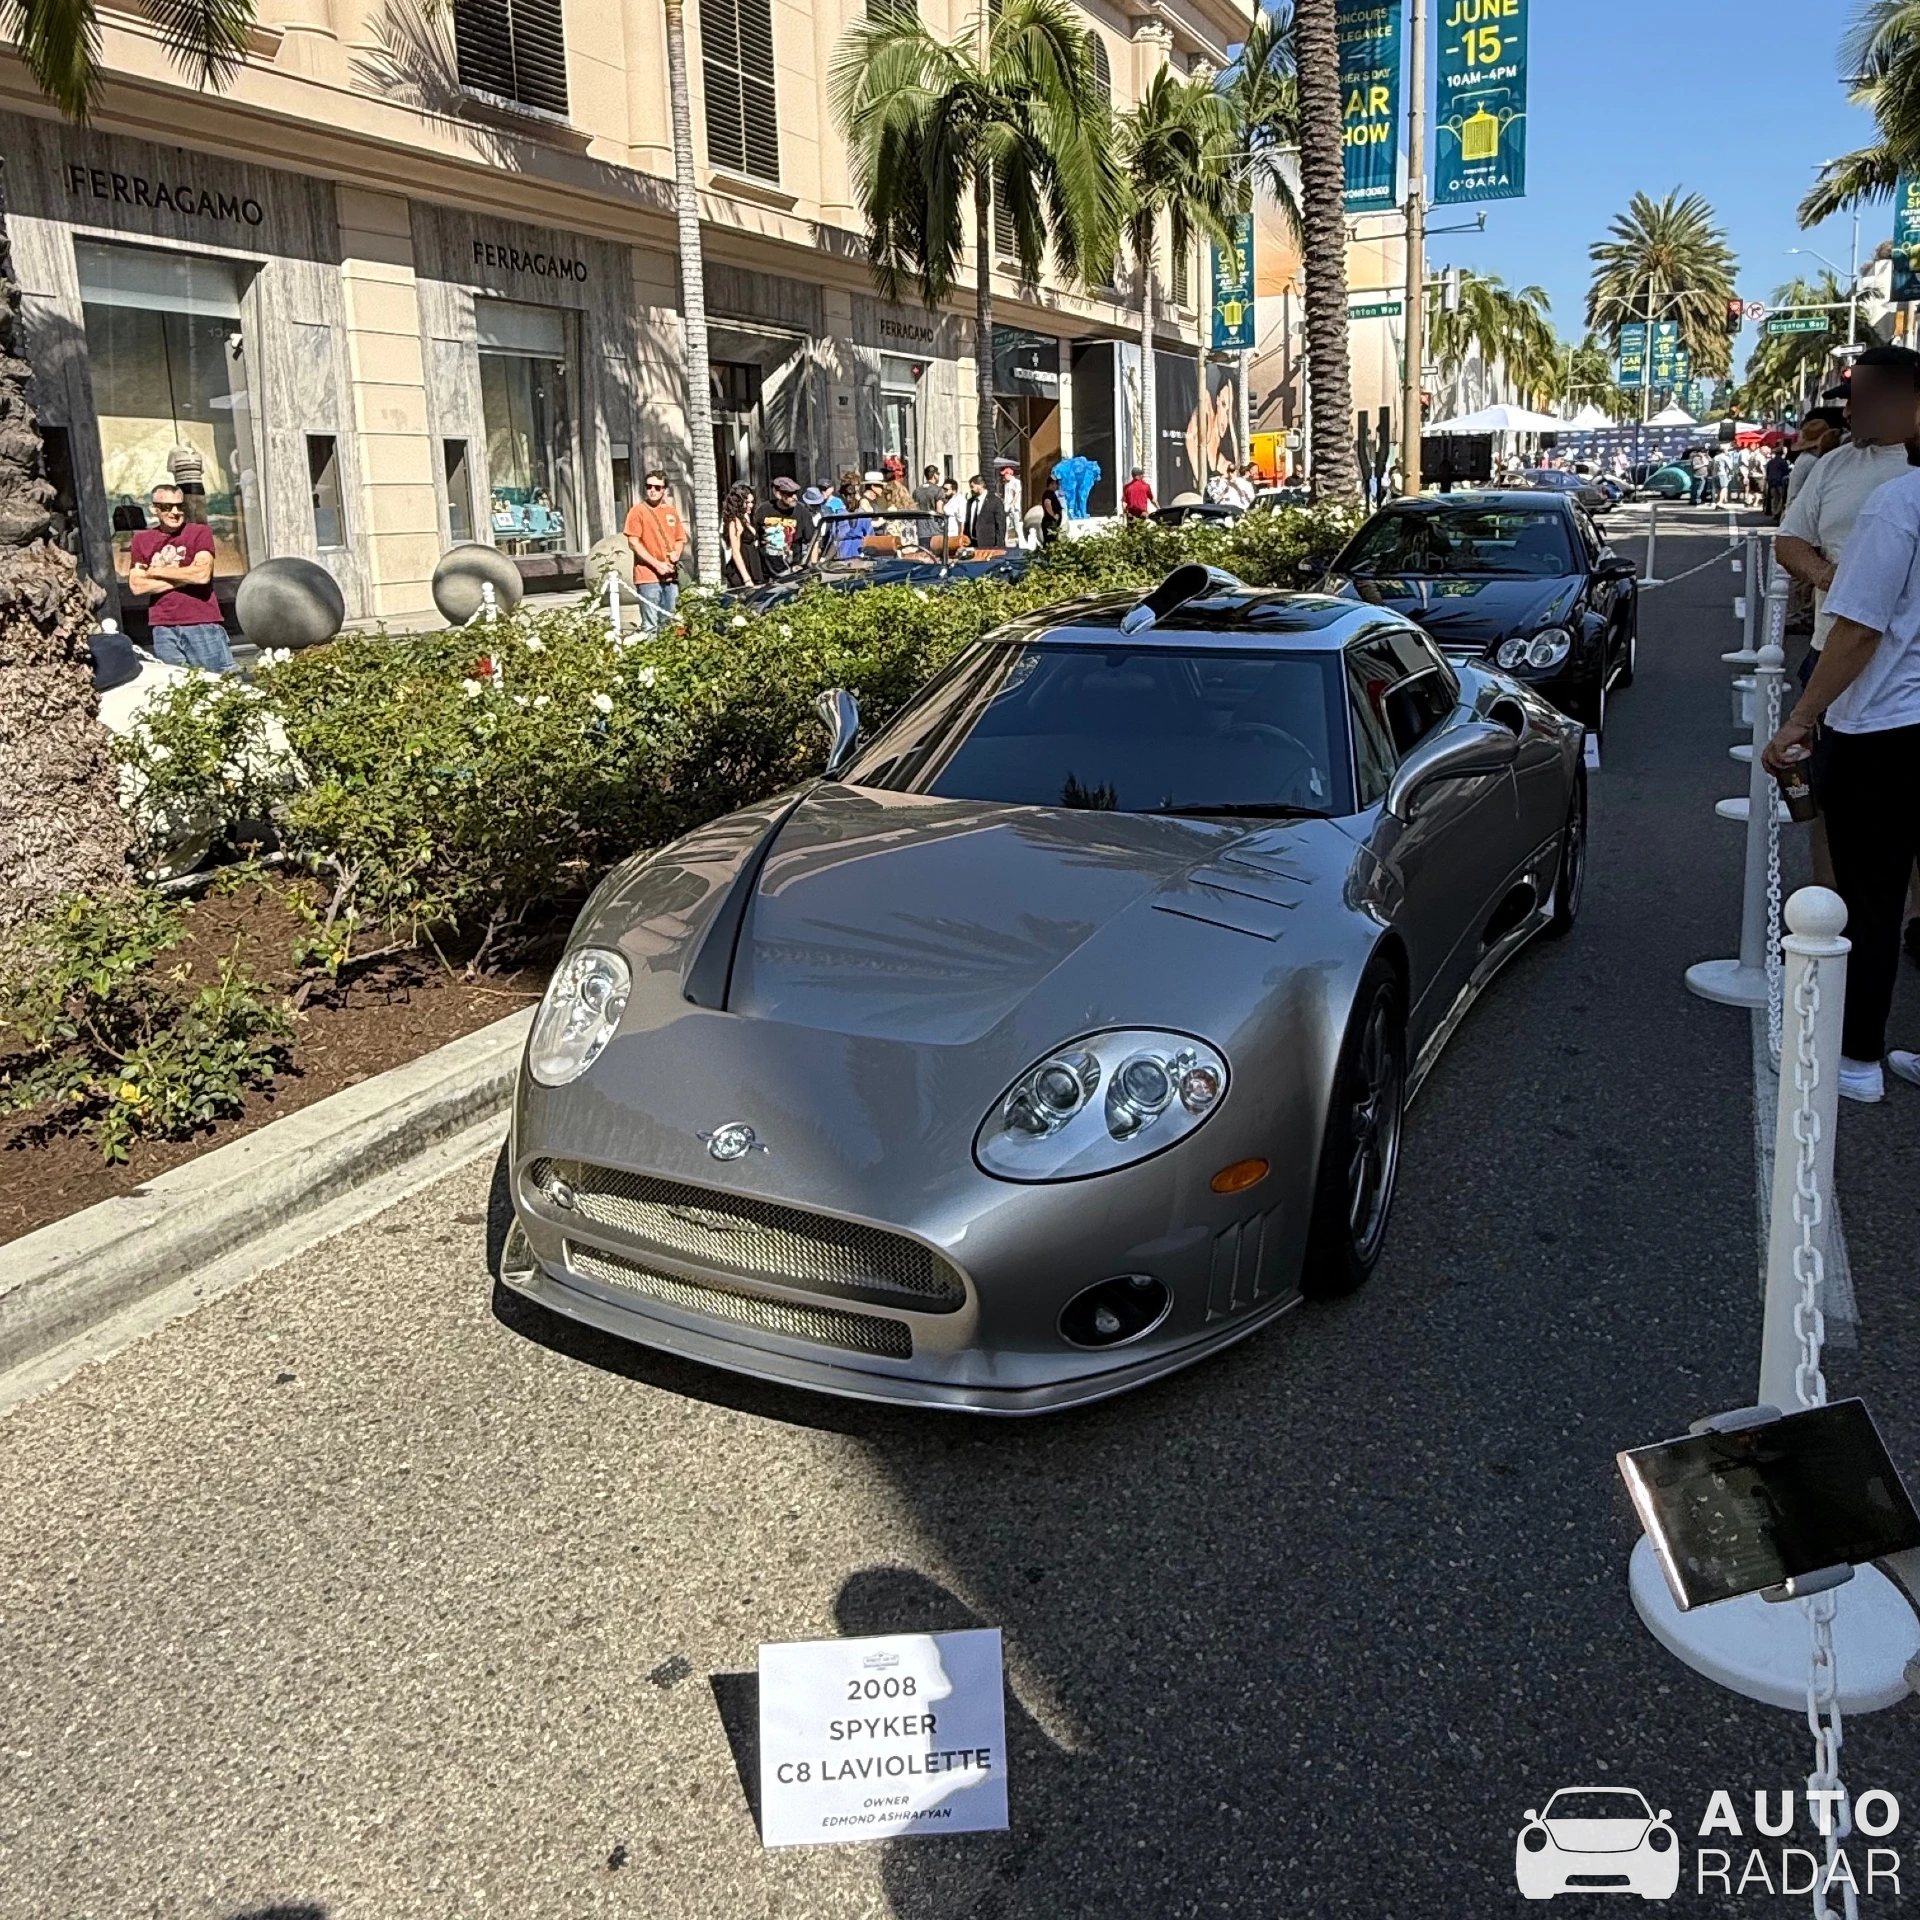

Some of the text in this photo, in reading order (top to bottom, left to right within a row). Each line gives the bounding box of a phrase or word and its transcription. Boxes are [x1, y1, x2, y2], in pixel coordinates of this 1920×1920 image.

[1335, 8, 1388, 25] ONCOURS
[1446, 0, 1519, 27] JUNE
[1339, 68, 1391, 84] HER'S DAY
[1344, 86, 1391, 119] AR
[1341, 122, 1390, 147] HOW
[1449, 174, 1509, 191] O'GARA
[68, 165, 263, 226] FERRAGAMO
[472, 240, 587, 282] FERRAGAMO
[1346, 306, 1399, 319] ghton Way
[881, 319, 934, 343] FERRAGAMO
[1770, 319, 1825, 332] Brighton Way
[1622, 356, 1641, 365] CAR
[847, 1676, 917, 1700] 2008
[829, 1713, 937, 1741] SPYKER
[777, 1748, 992, 1784] C8 LAVIOLETTE
[863, 1796, 909, 1808] OWNER
[822, 1808, 953, 1827] EDMOND ASHRAFYAN
